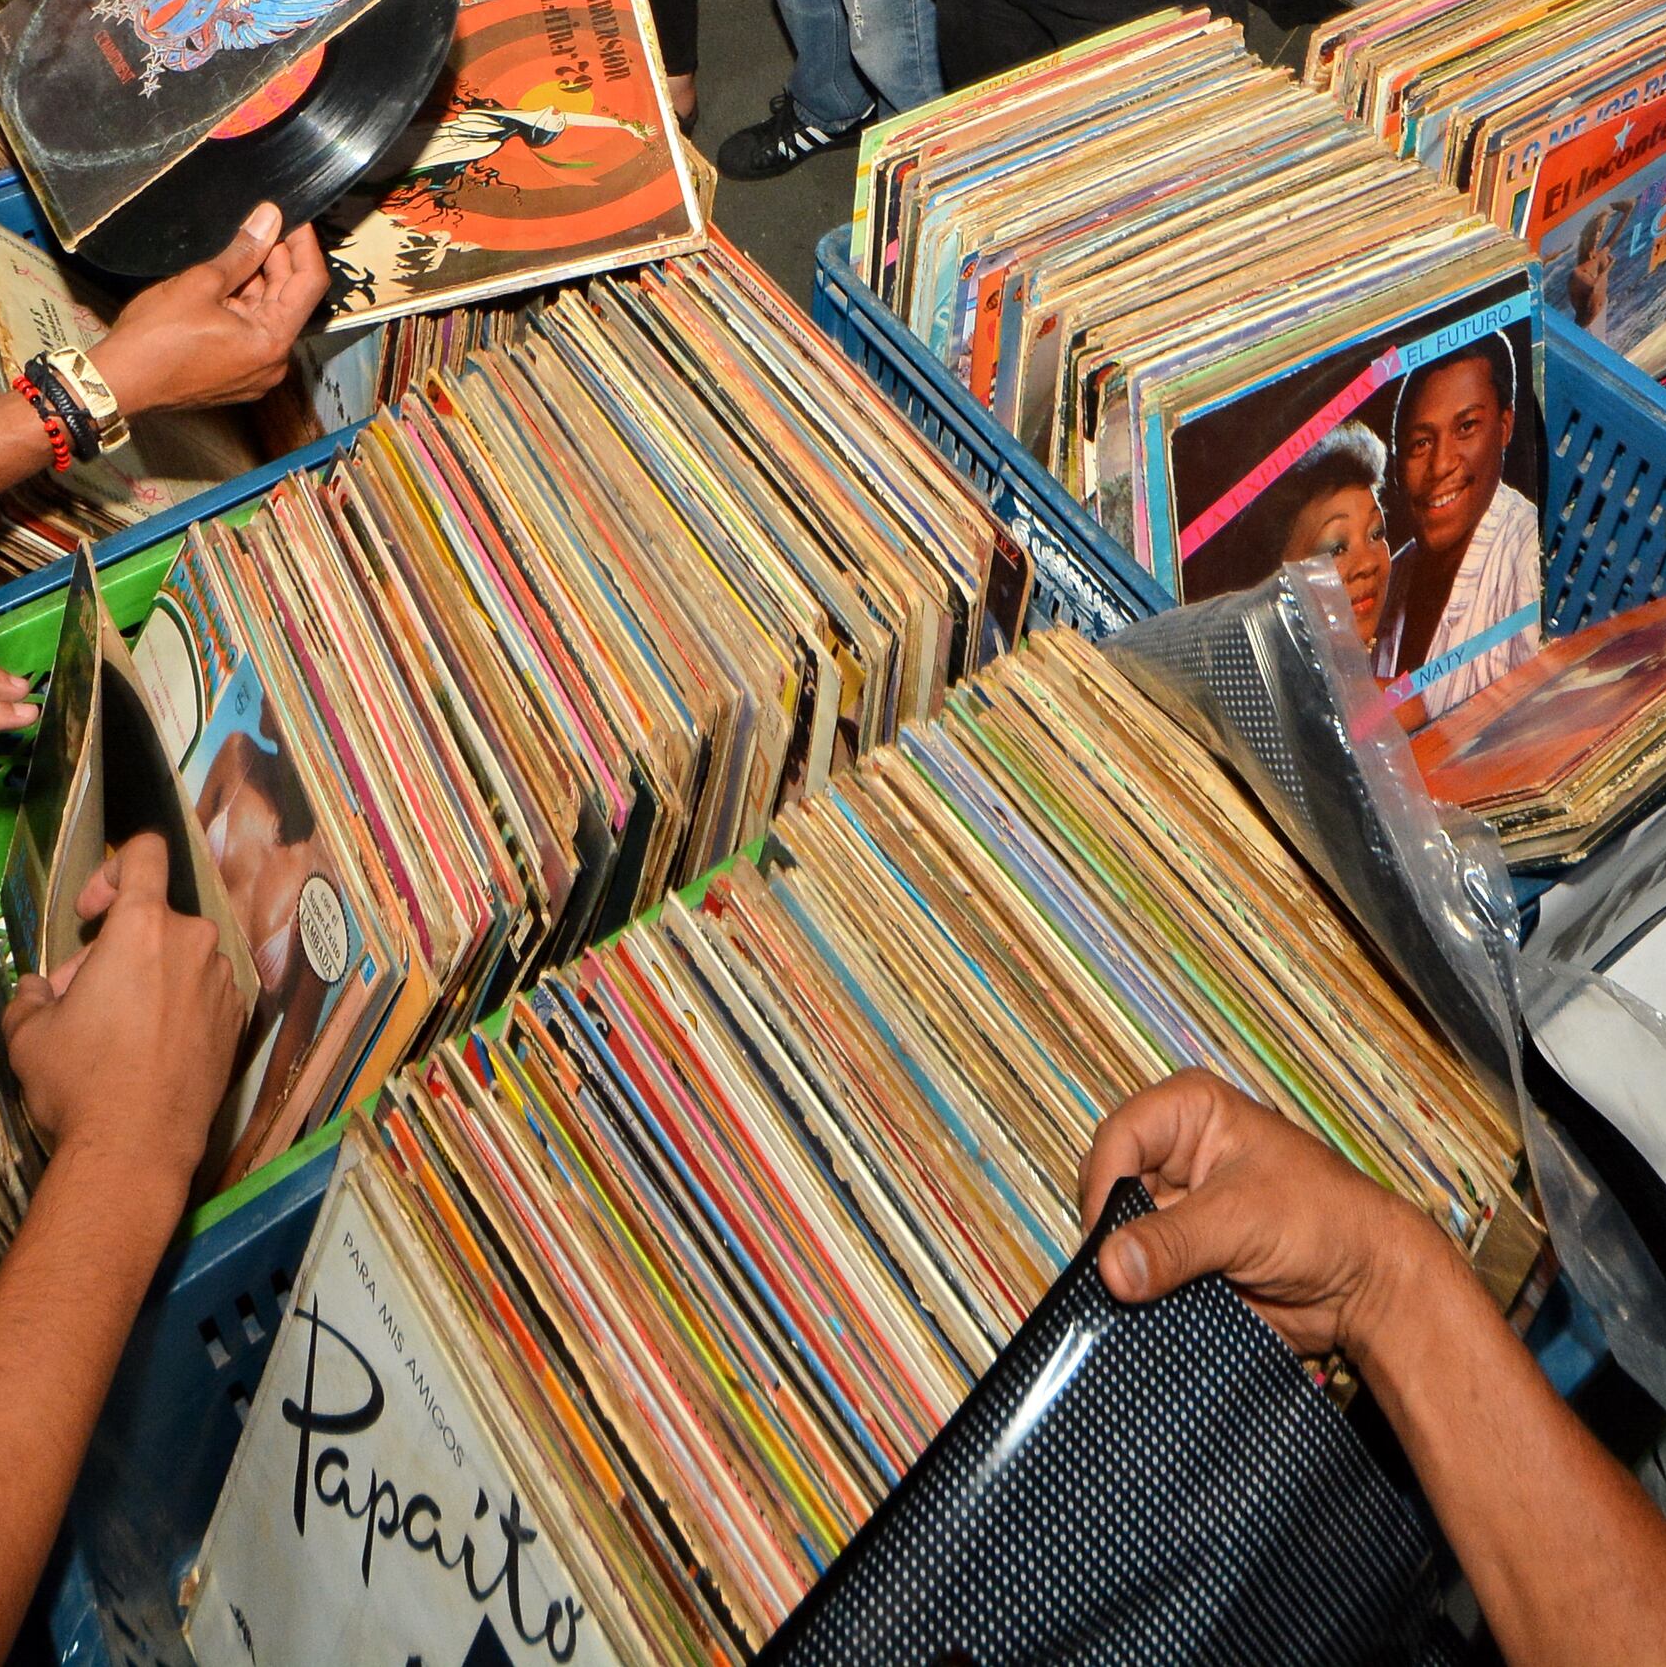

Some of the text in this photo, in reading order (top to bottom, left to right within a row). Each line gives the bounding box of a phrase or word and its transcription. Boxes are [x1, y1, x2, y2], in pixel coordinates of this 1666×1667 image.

[1543, 181, 1571, 222] El
[1195, 302, 1514, 538] LA EXPERIENCIA Y EL FUTURO
[1391, 649, 1467, 701] Y NATY
[301, 909, 334, 978] LAMBADA
[320, 890, 339, 928] con el
[342, 1230, 466, 1469] PARA MIS AMIGOS
[282, 1291, 585, 1664] Papaito
